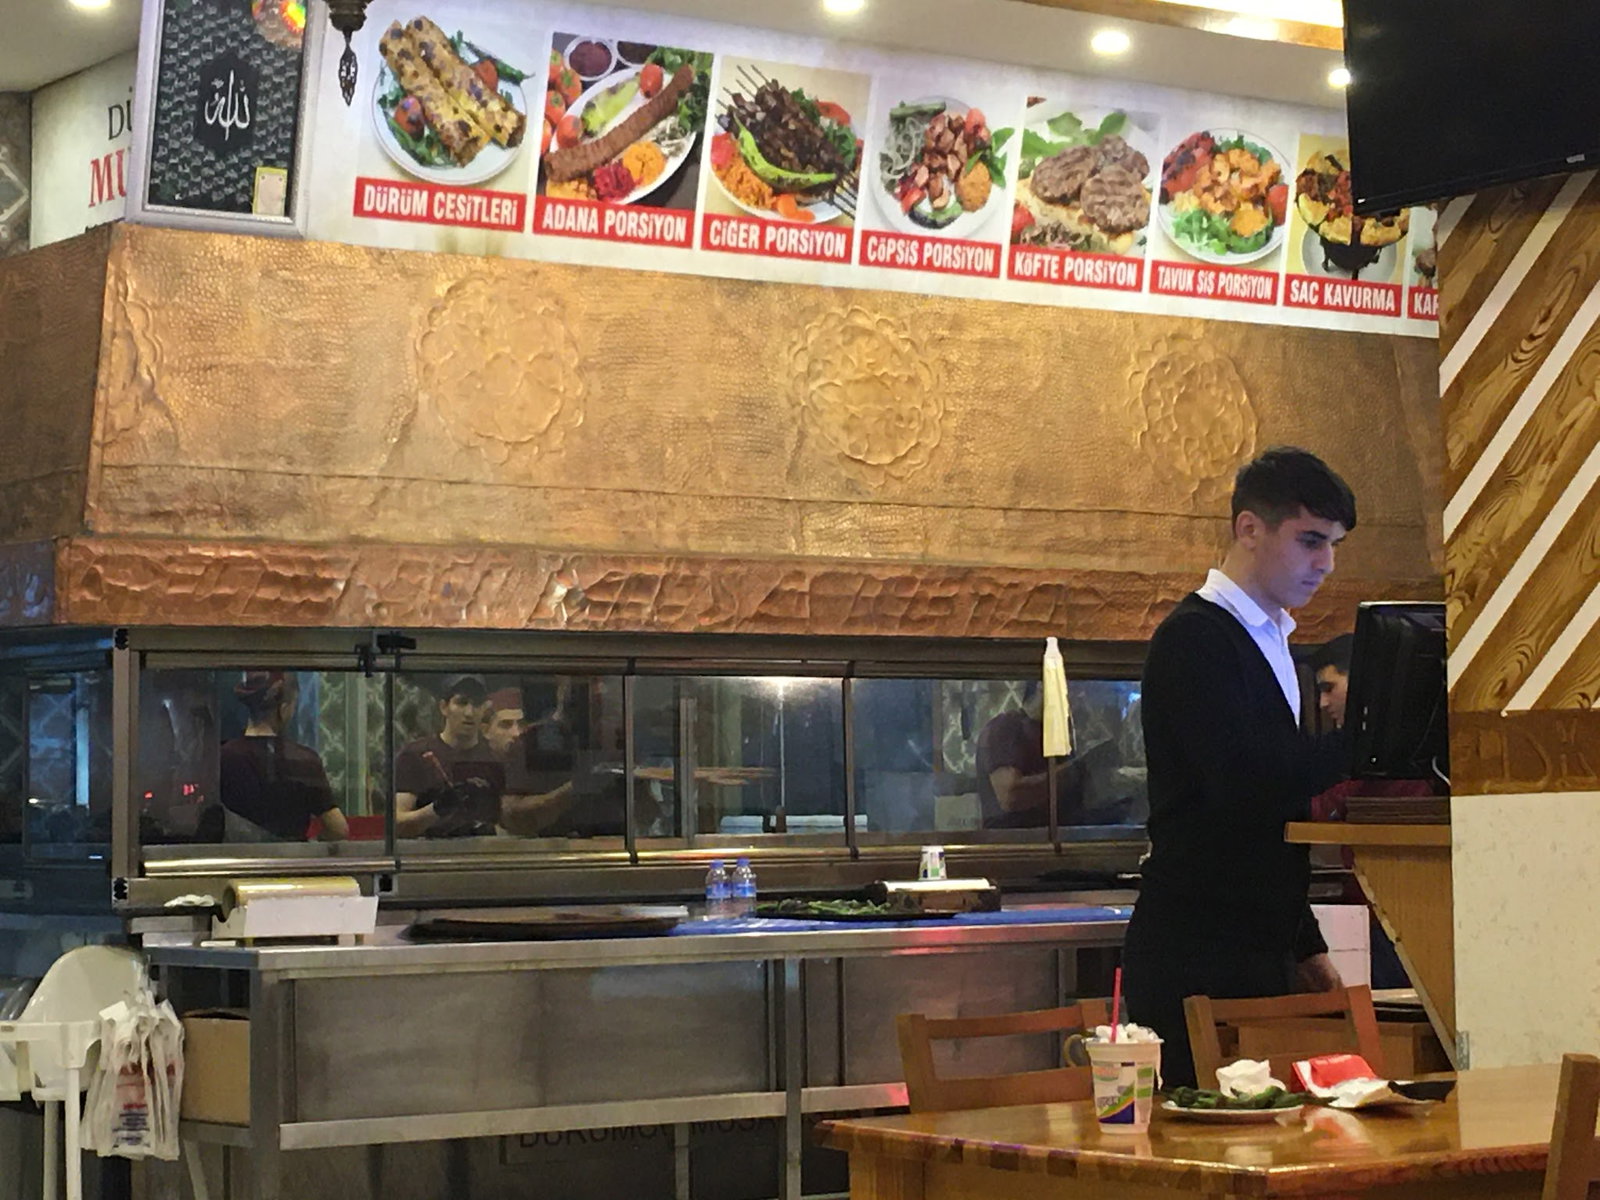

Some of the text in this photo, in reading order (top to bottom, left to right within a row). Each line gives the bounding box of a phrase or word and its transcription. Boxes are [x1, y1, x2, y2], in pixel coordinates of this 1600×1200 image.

[363, 184, 429, 217] DÜRÜM
[542, 203, 599, 234] ADANA
[1014, 251, 1060, 279] KÖFTE
[1157, 265, 1195, 292] TAVUK
[1323, 283, 1395, 312] KAVURMA
